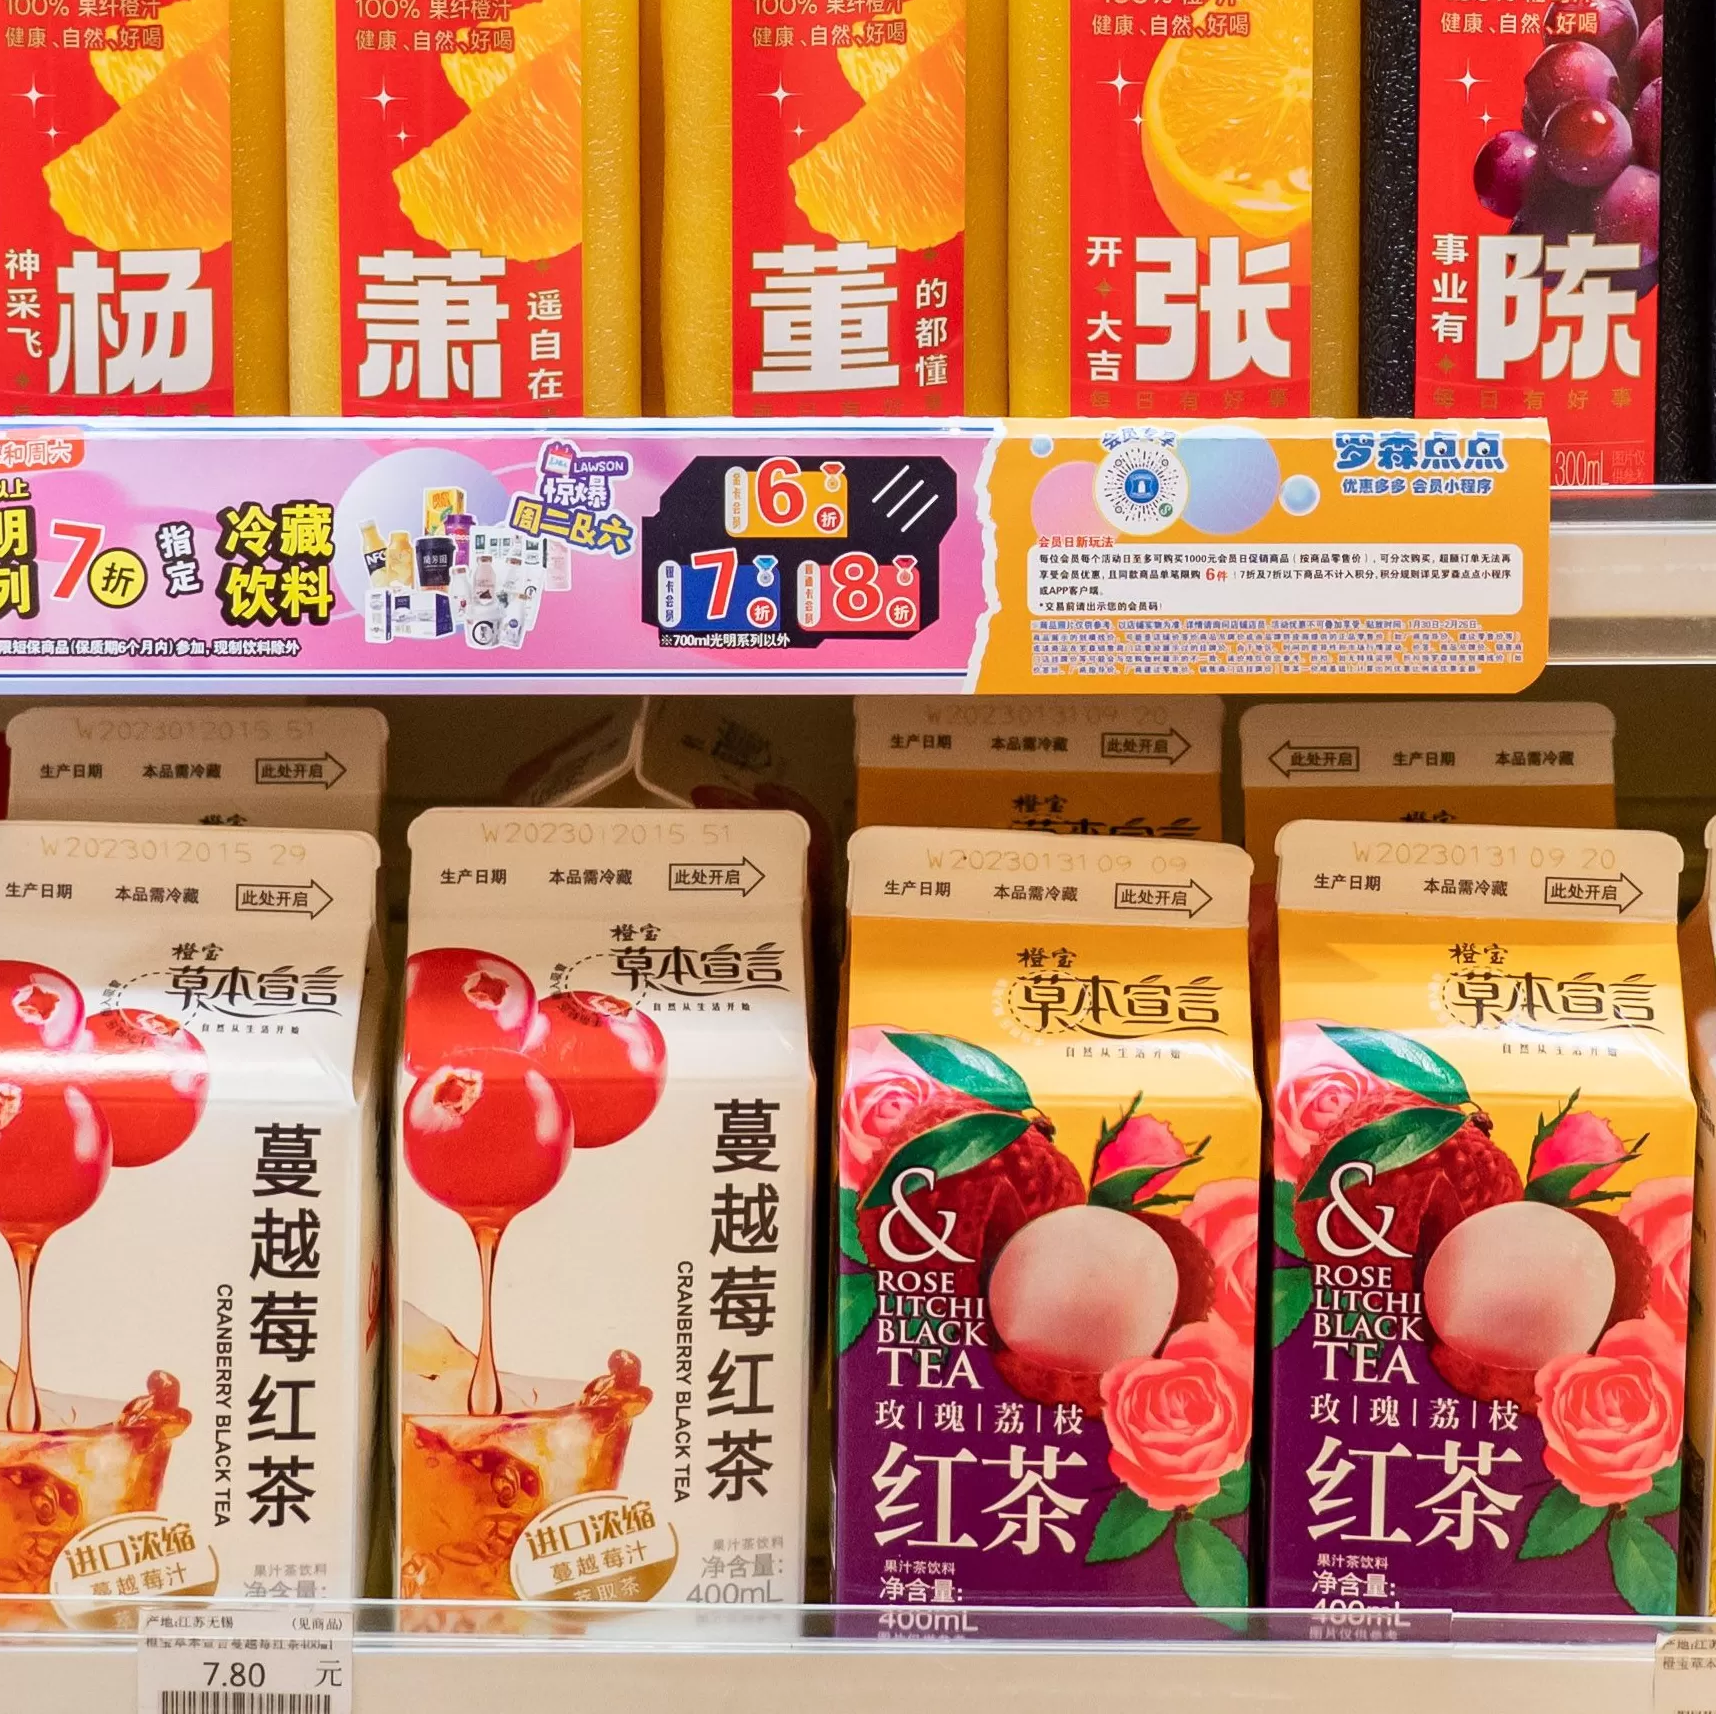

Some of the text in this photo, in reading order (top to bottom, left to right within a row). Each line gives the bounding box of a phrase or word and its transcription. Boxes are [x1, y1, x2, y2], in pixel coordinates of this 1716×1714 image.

[48, 248, 215, 395] 杨
[357, 250, 509, 400] 萧
[527, 288, 564, 401] 遥自在
[751, 240, 900, 393] 董
[915, 278, 948, 388] 的都懂
[1135, 235, 1291, 382] 张
[1432, 233, 1469, 345] 事业有
[1476, 234, 1642, 381] 陈
[573, 461, 624, 474] LAWSON
[1039, 536, 1114, 548] 会员日新玩法
[5, 880, 308, 909] 生产日期 本品需冷藏 此处开启
[247, 1122, 322, 1529] 蔓越莓红茶
[707, 1099, 781, 1504] 蔓越莓红茶
[877, 1270, 955, 1295] ROSE
[877, 1295, 985, 1320] LITCHI
[1313, 1314, 1423, 1342] BLACK
[1315, 1264, 1391, 1287] ROSE
[674, 1260, 694, 1503] CRANBERRY BLACK TEA
[877, 1318, 987, 1346] BLACK
[877, 1347, 981, 1391] TEA
[1313, 1342, 1419, 1386] TEA
[872, 1441, 1088, 1555] 红茶
[1306, 1440, 1523, 1554] 红茶
